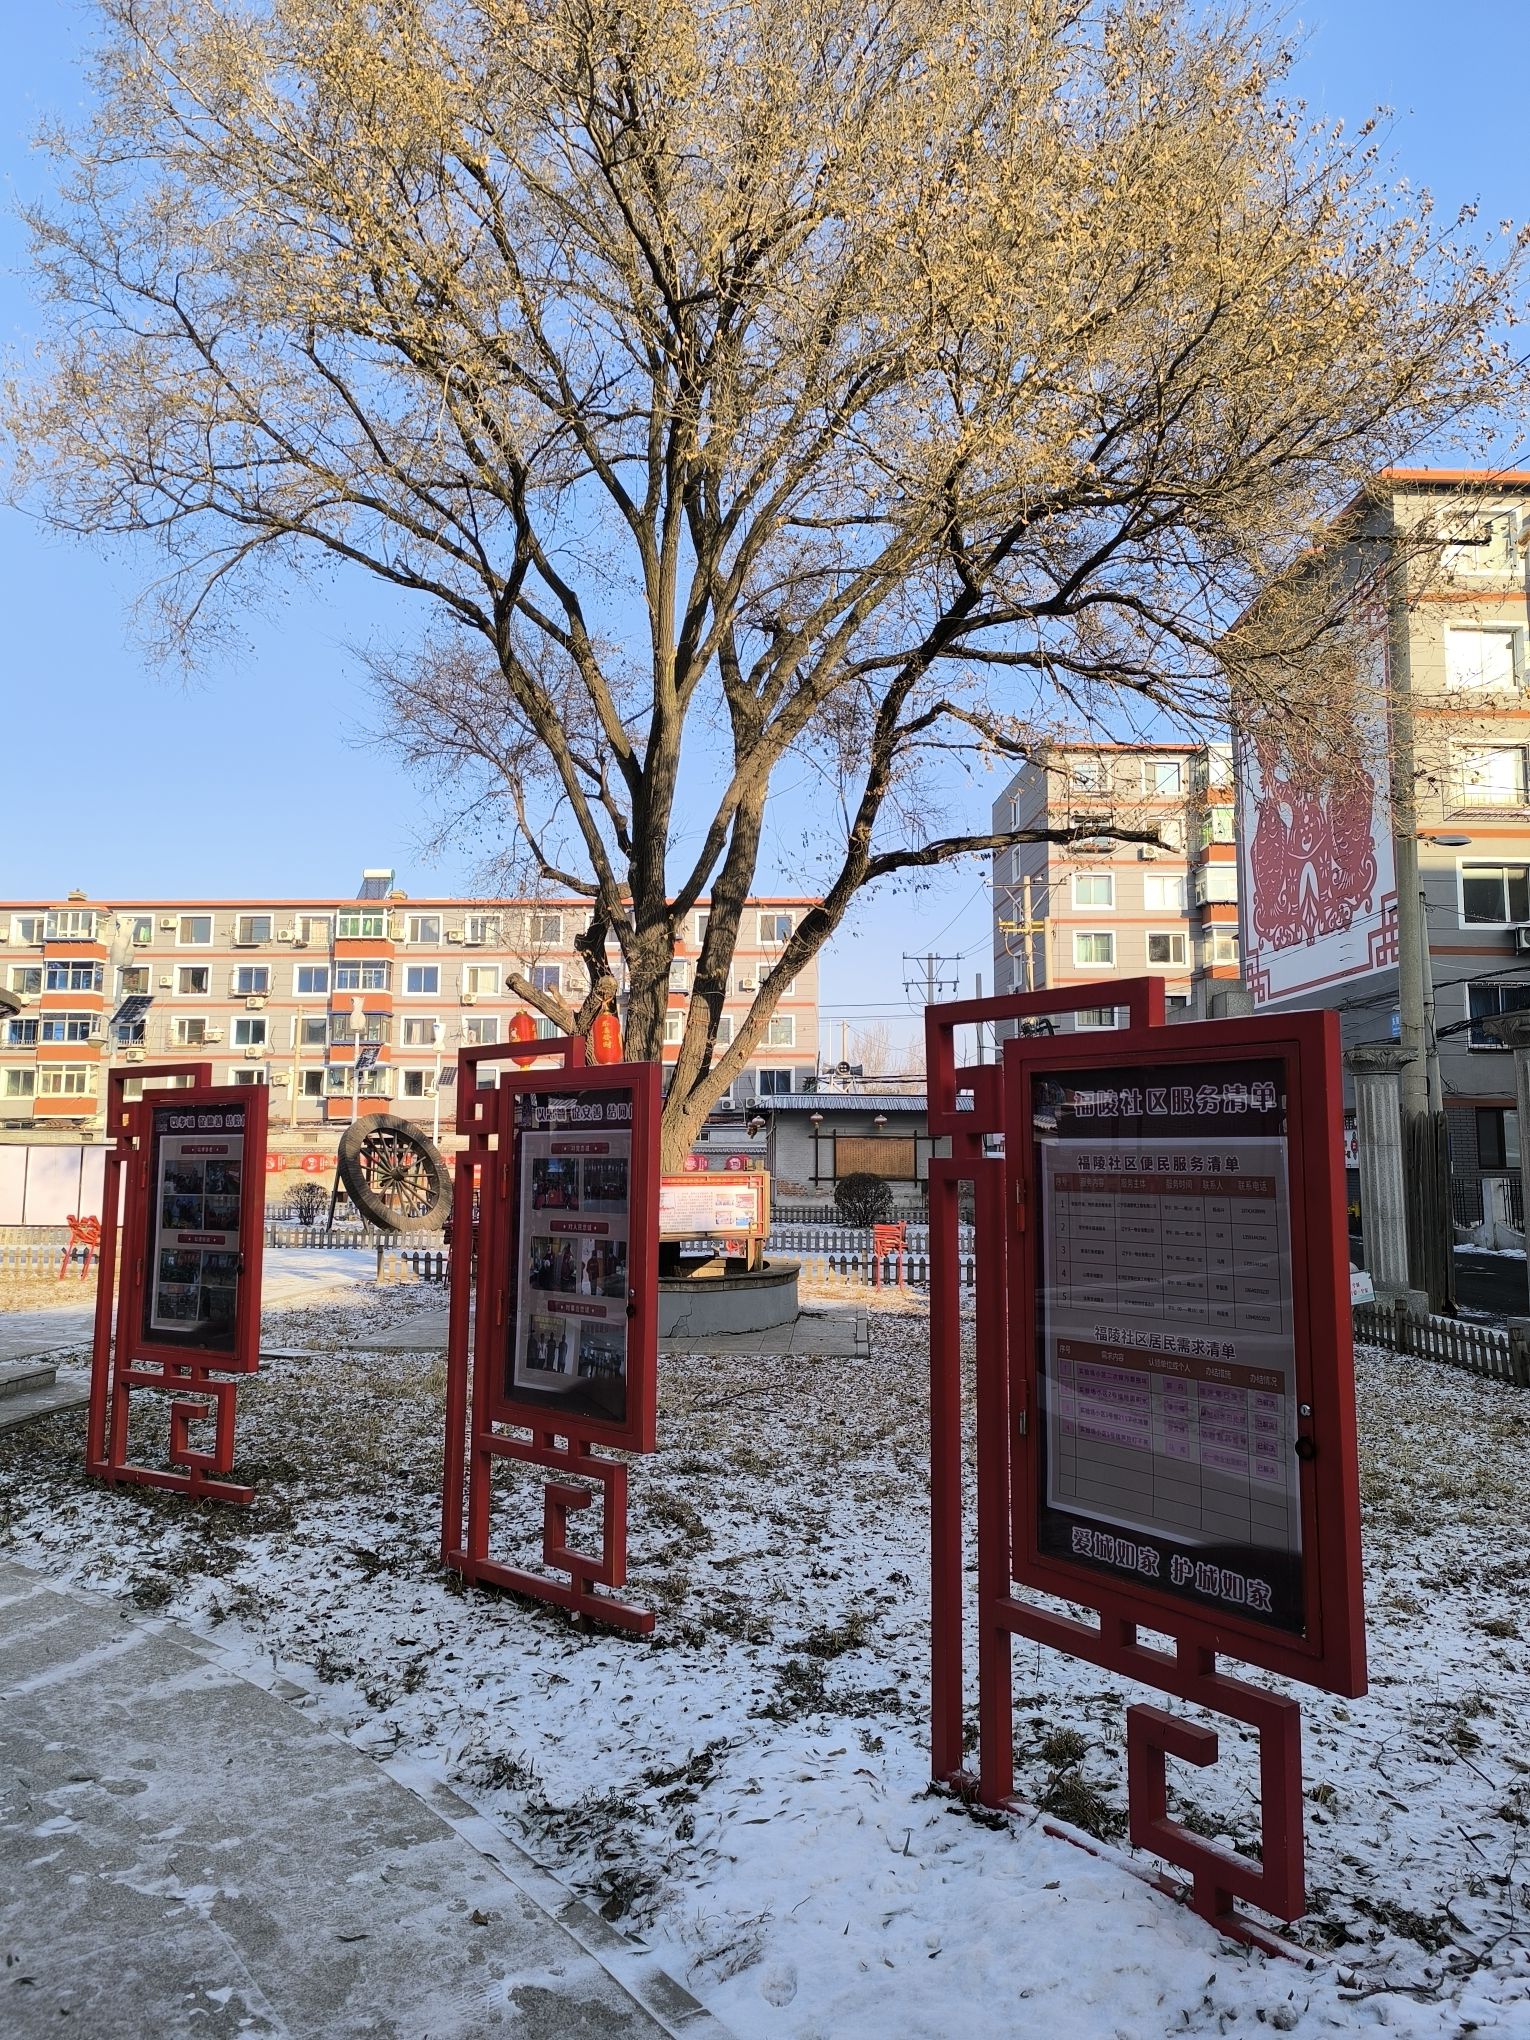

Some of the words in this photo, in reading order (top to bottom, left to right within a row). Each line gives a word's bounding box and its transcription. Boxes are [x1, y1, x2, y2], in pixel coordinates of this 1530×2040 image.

[607, 1103, 633, 1120] 结同
[1074, 1082, 1277, 1118] 福陵社区服务清单
[1077, 1154, 1240, 1173] 福陵社区便民服务清单
[1079, 1178, 1105, 1189] 服务内容
[1120, 1178, 1146, 1189] 服务主体
[1165, 1180, 1193, 1190] 服务时间
[1202, 1180, 1223, 1192] 联系人
[1237, 1180, 1268, 1192] 联系电话
[1094, 1325, 1237, 1360] 福陵社区居民需求清单
[1059, 1344, 1071, 1354] 序号
[1101, 1350, 1125, 1361] 需求内容
[1205, 1367, 1232, 1379] 办结措施
[1248, 1373, 1279, 1388] 办结情况
[1072, 1526, 1160, 1577] 爱城如家
[1171, 1555, 1273, 1612] 护城如家
